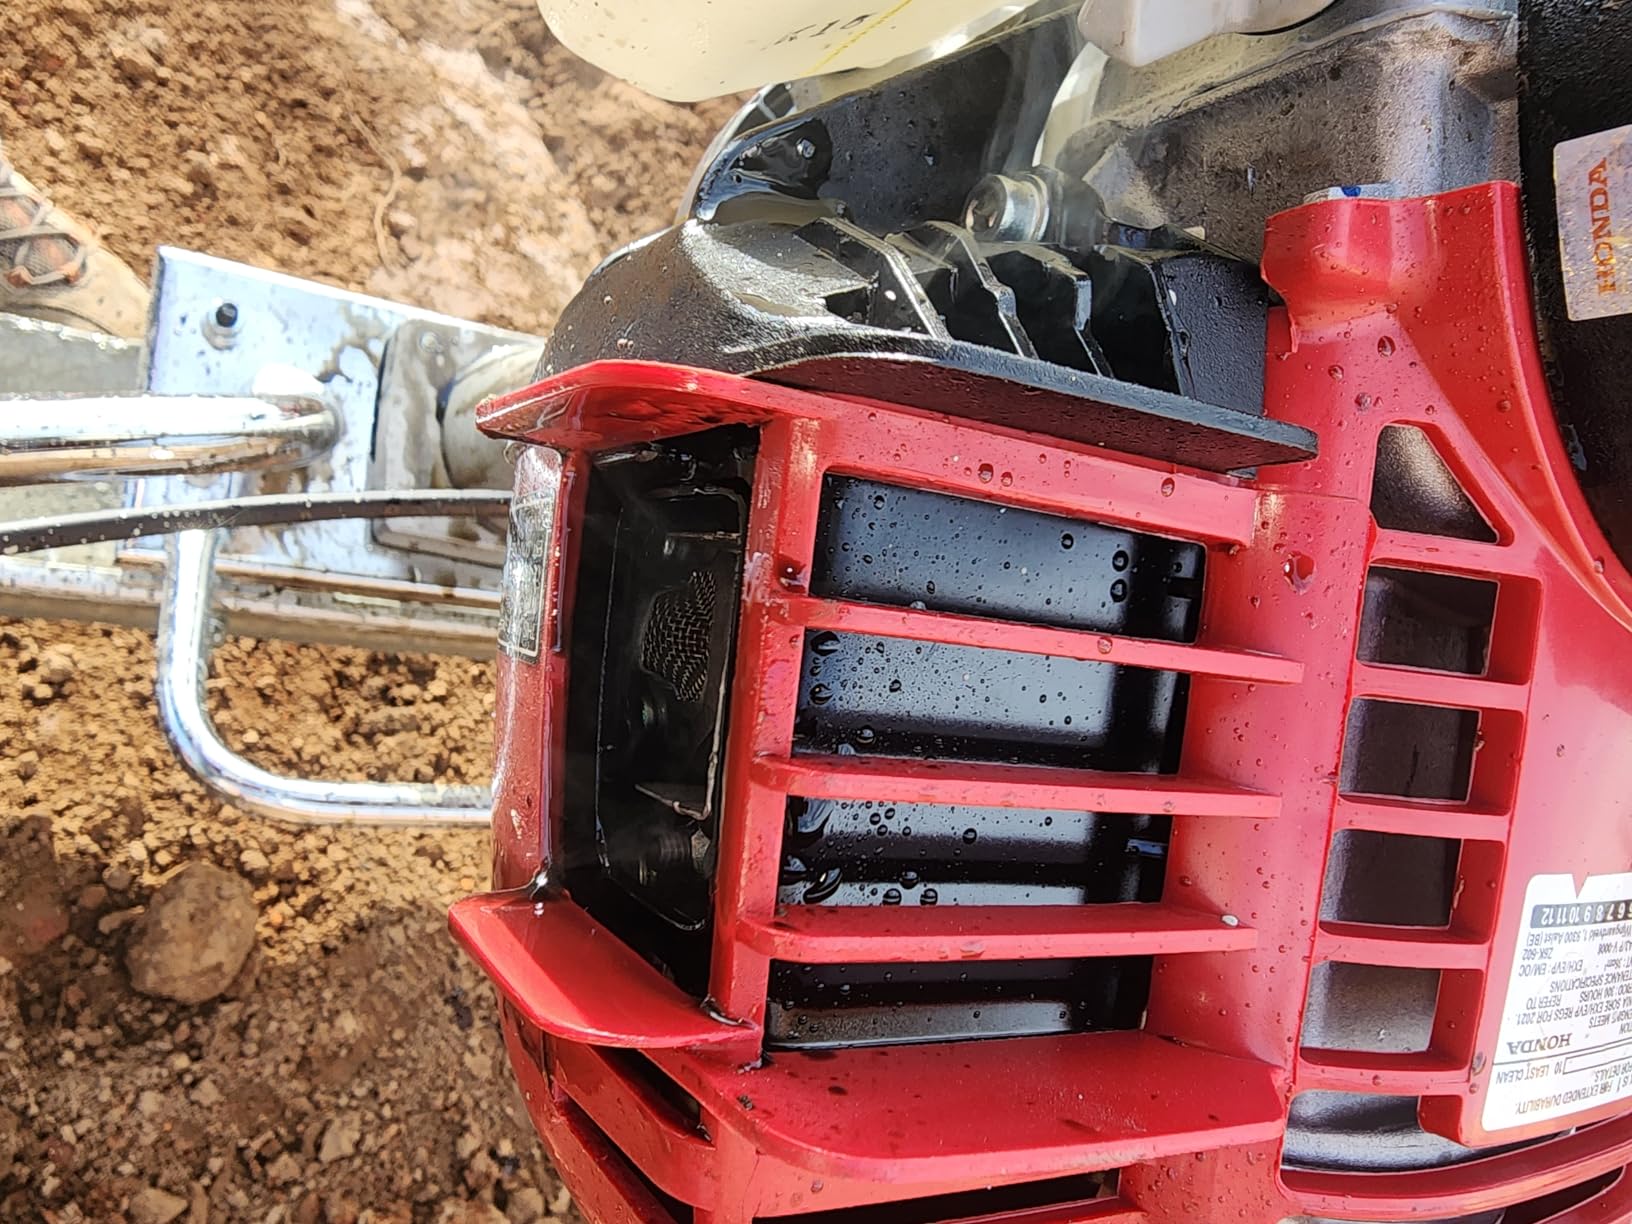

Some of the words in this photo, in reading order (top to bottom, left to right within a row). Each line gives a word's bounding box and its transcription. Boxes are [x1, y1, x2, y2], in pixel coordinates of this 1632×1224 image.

[1588, 157, 1617, 295] HONDA
[1541, 908, 1554, 925] 12
[1556, 907, 1567, 924] 11
[1569, 907, 1580, 923] 10
[1584, 906, 1592, 922] 9
[1595, 905, 1604, 922] 8
[1606, 903, 1615, 920] 7
[1618, 903, 1626, 919] 6
[1536, 1009, 1553, 1024] FOR
[1507, 1033, 1573, 1055] HONDA
[1496, 1069, 1524, 1084] CLEAN
[1525, 1064, 1550, 1080] LEAST
[1562, 1085, 1599, 1104] EXTENDED
